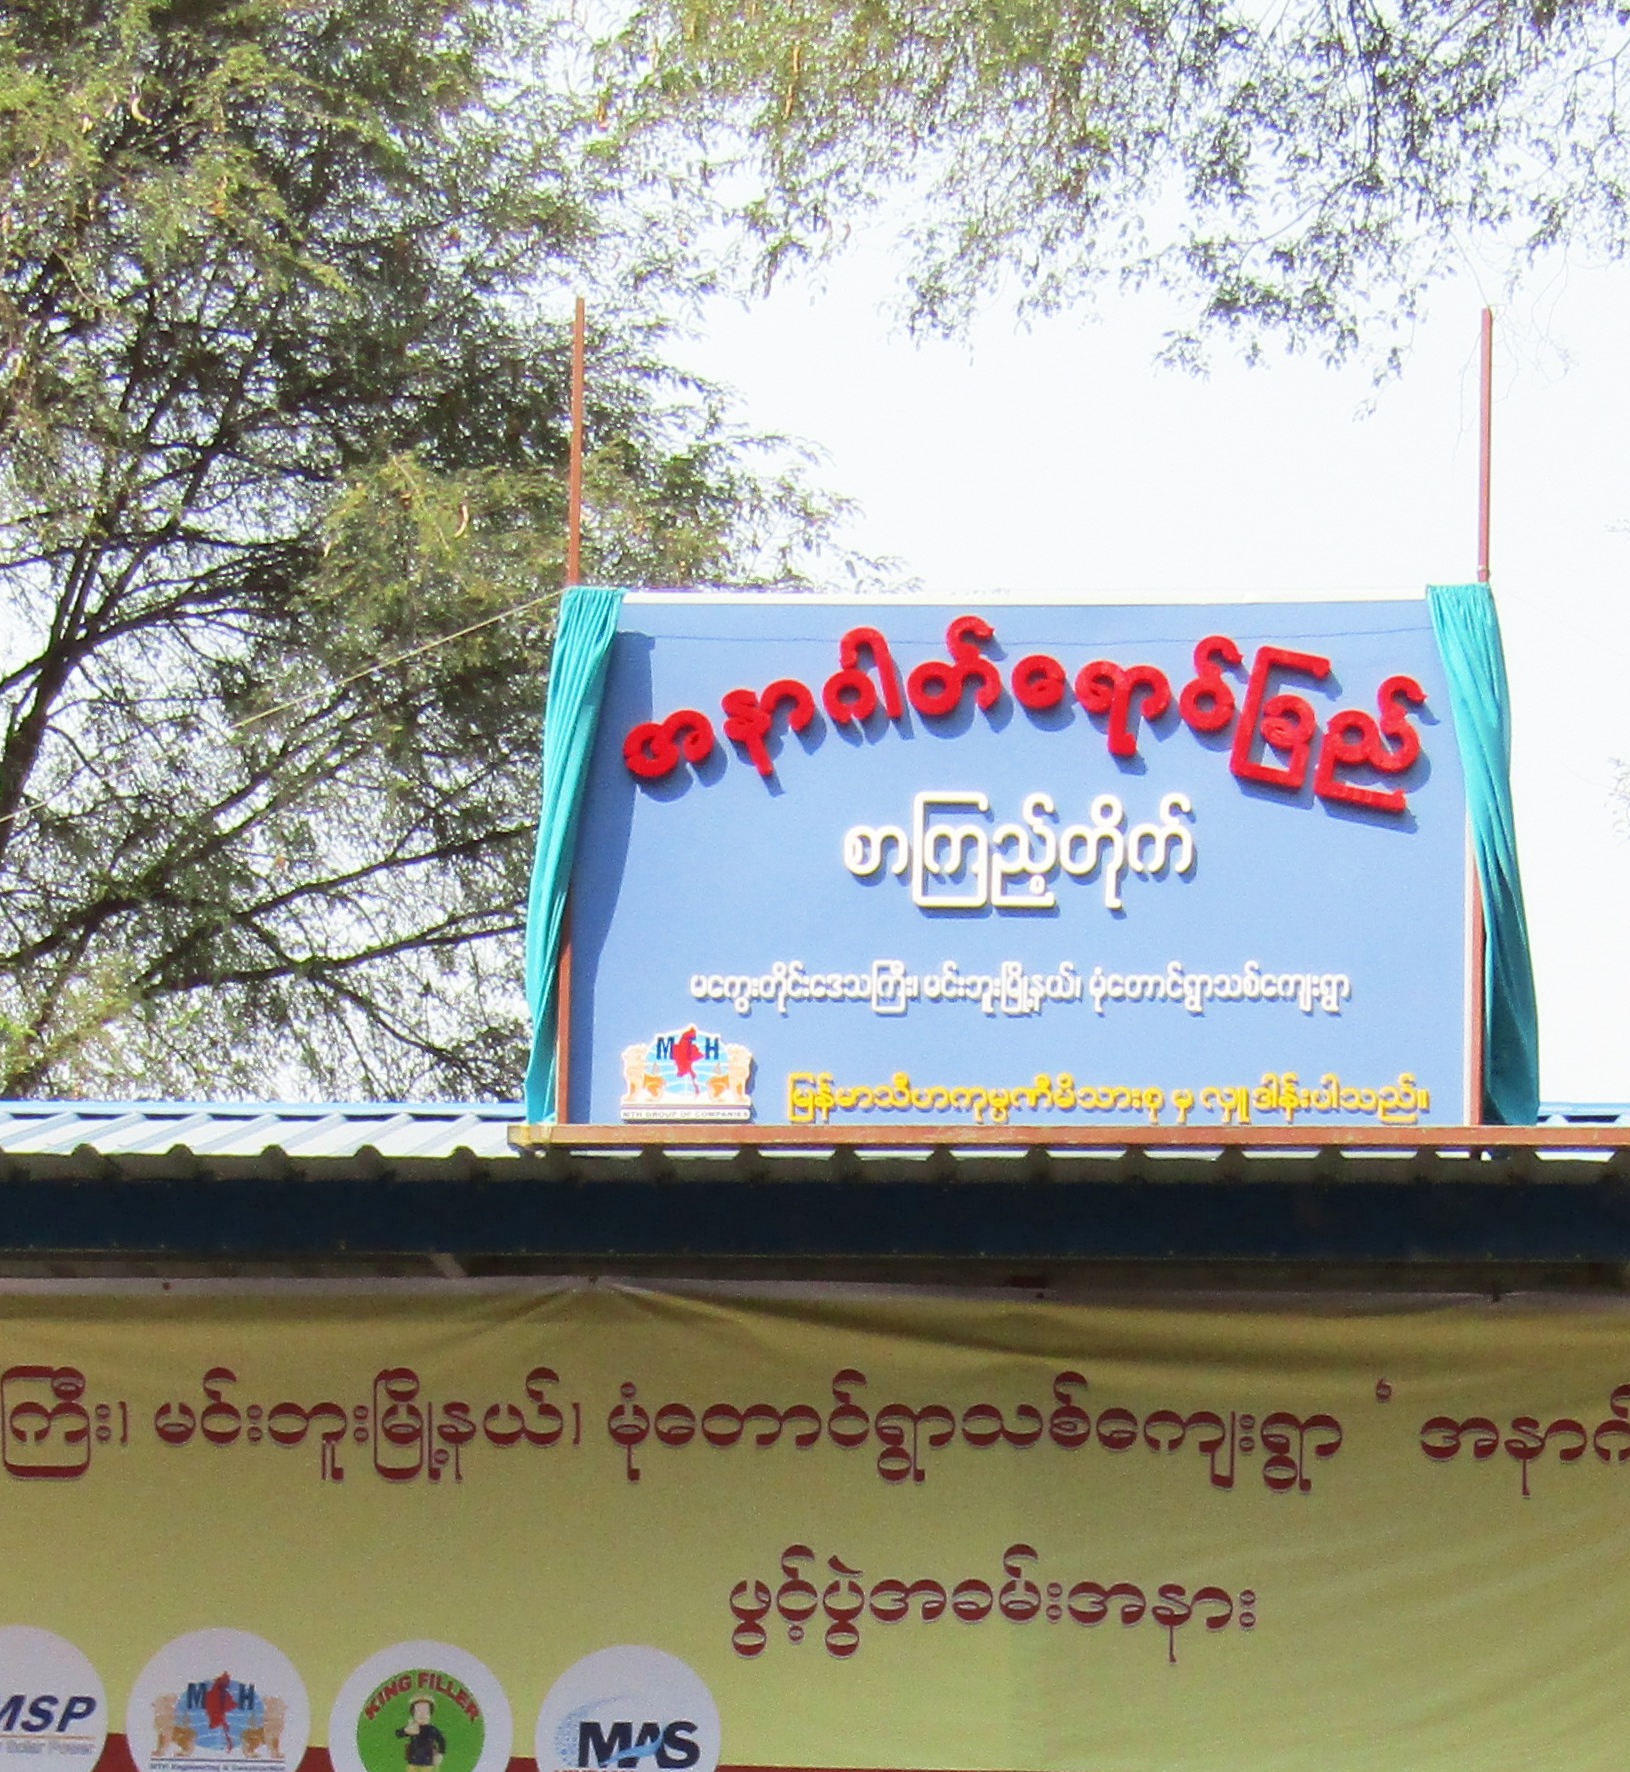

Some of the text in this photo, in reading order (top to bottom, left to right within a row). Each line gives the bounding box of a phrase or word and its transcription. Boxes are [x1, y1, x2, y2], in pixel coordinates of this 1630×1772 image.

[843, 791, 1195, 909] စာကြည့်တိုက်
[365, 1671, 480, 1723] KING FILLER
[577, 1720, 701, 1770] MAS
